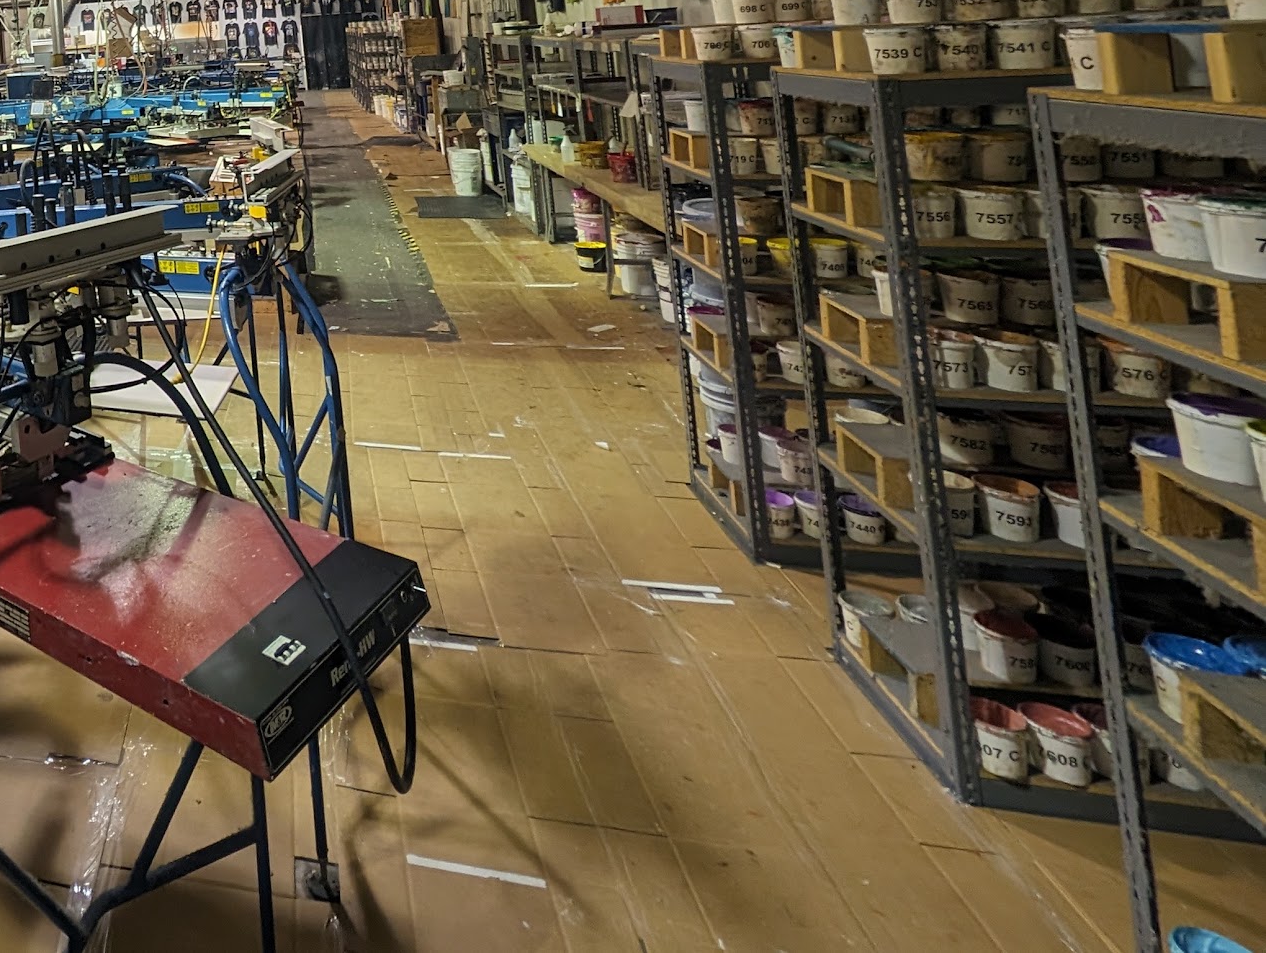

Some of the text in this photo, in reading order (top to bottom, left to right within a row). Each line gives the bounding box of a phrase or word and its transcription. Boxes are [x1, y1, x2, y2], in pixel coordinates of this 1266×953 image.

[740, 4, 767, 14] 698 C
[781, 3, 800, 11] 699
[752, 41, 771, 49] 706
[940, 43, 979, 56] 7540
[999, 40, 1052, 53] 7541 C
[874, 47, 922, 59] 7539 C
[1080, 56, 1095, 70] C
[730, 154, 755, 163] 719 C
[915, 211, 951, 223] 7556
[976, 212, 1014, 225] 7557
[1009, 749, 1020, 763] C
